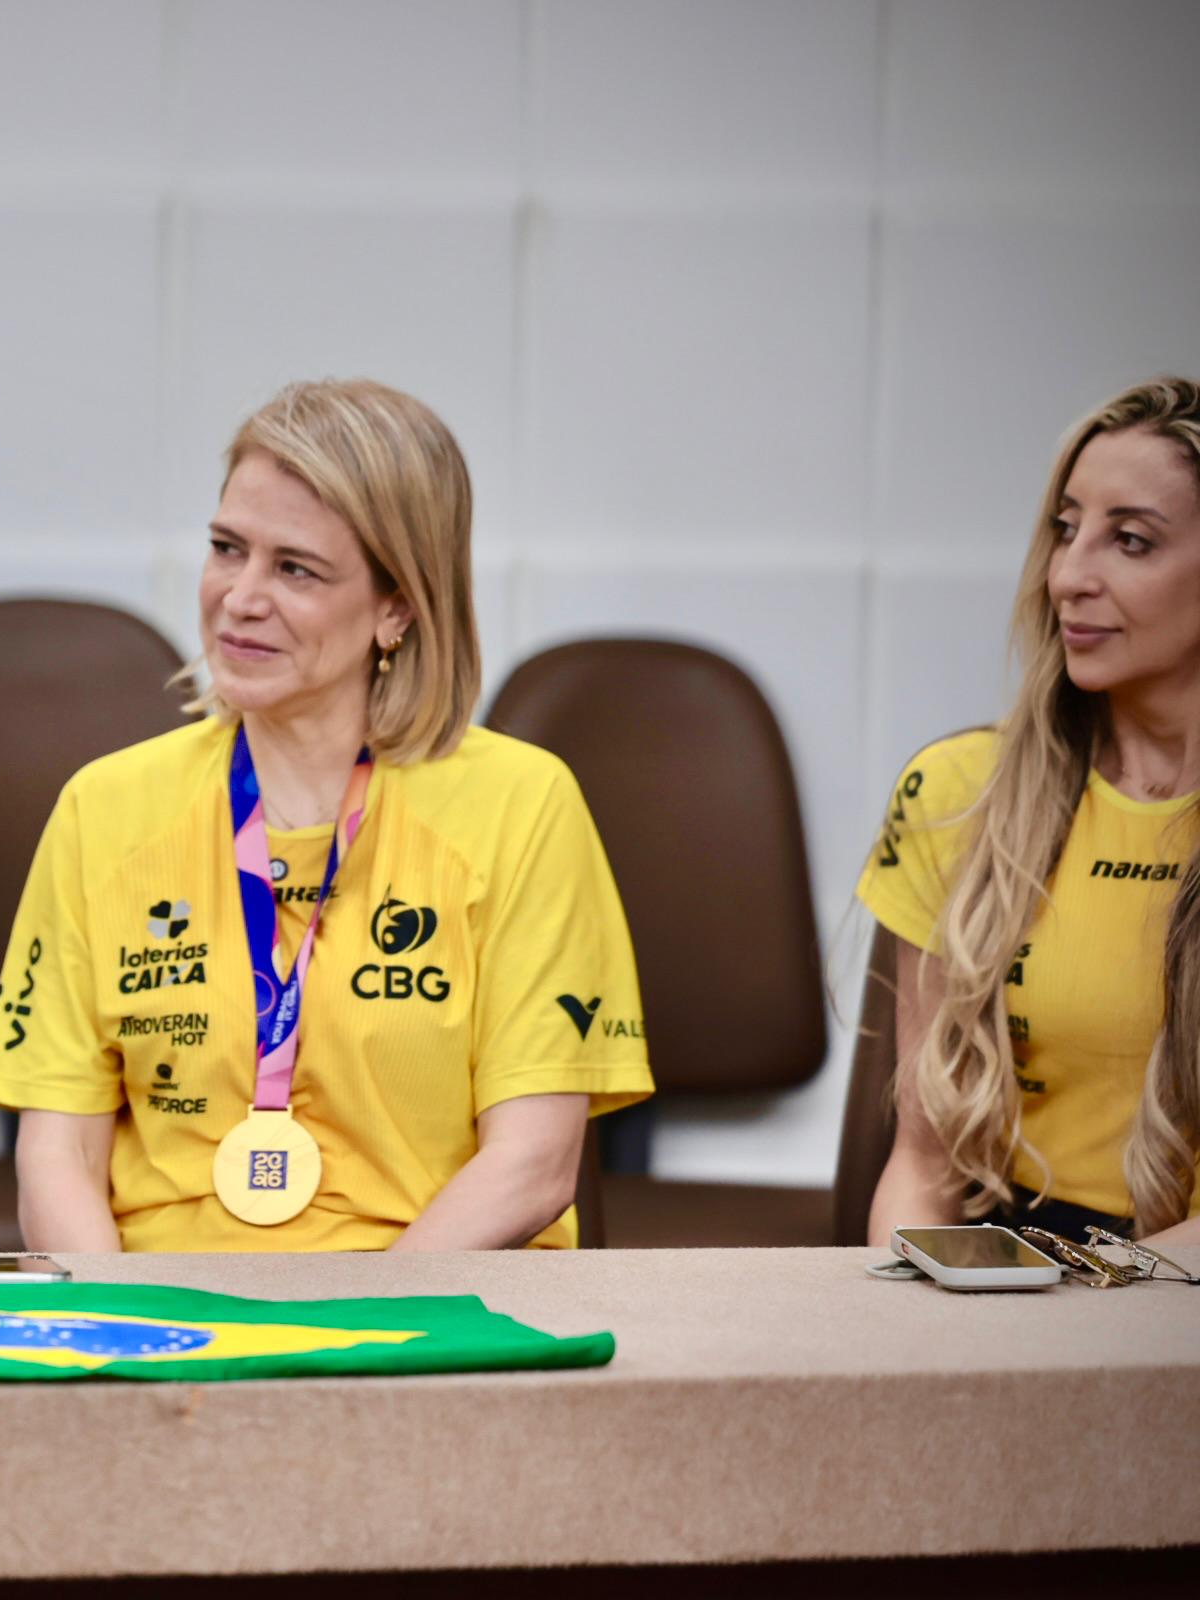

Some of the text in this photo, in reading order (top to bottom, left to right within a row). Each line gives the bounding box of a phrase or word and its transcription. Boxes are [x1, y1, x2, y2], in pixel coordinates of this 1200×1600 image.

[119, 941, 208, 968] loterias
[118, 962, 207, 994] CAIXA
[351, 964, 450, 1002] CBG
[4, 937, 42, 1051] vivo
[117, 1013, 209, 1037] ATROVERAN
[171, 1032, 206, 1046] HOT
